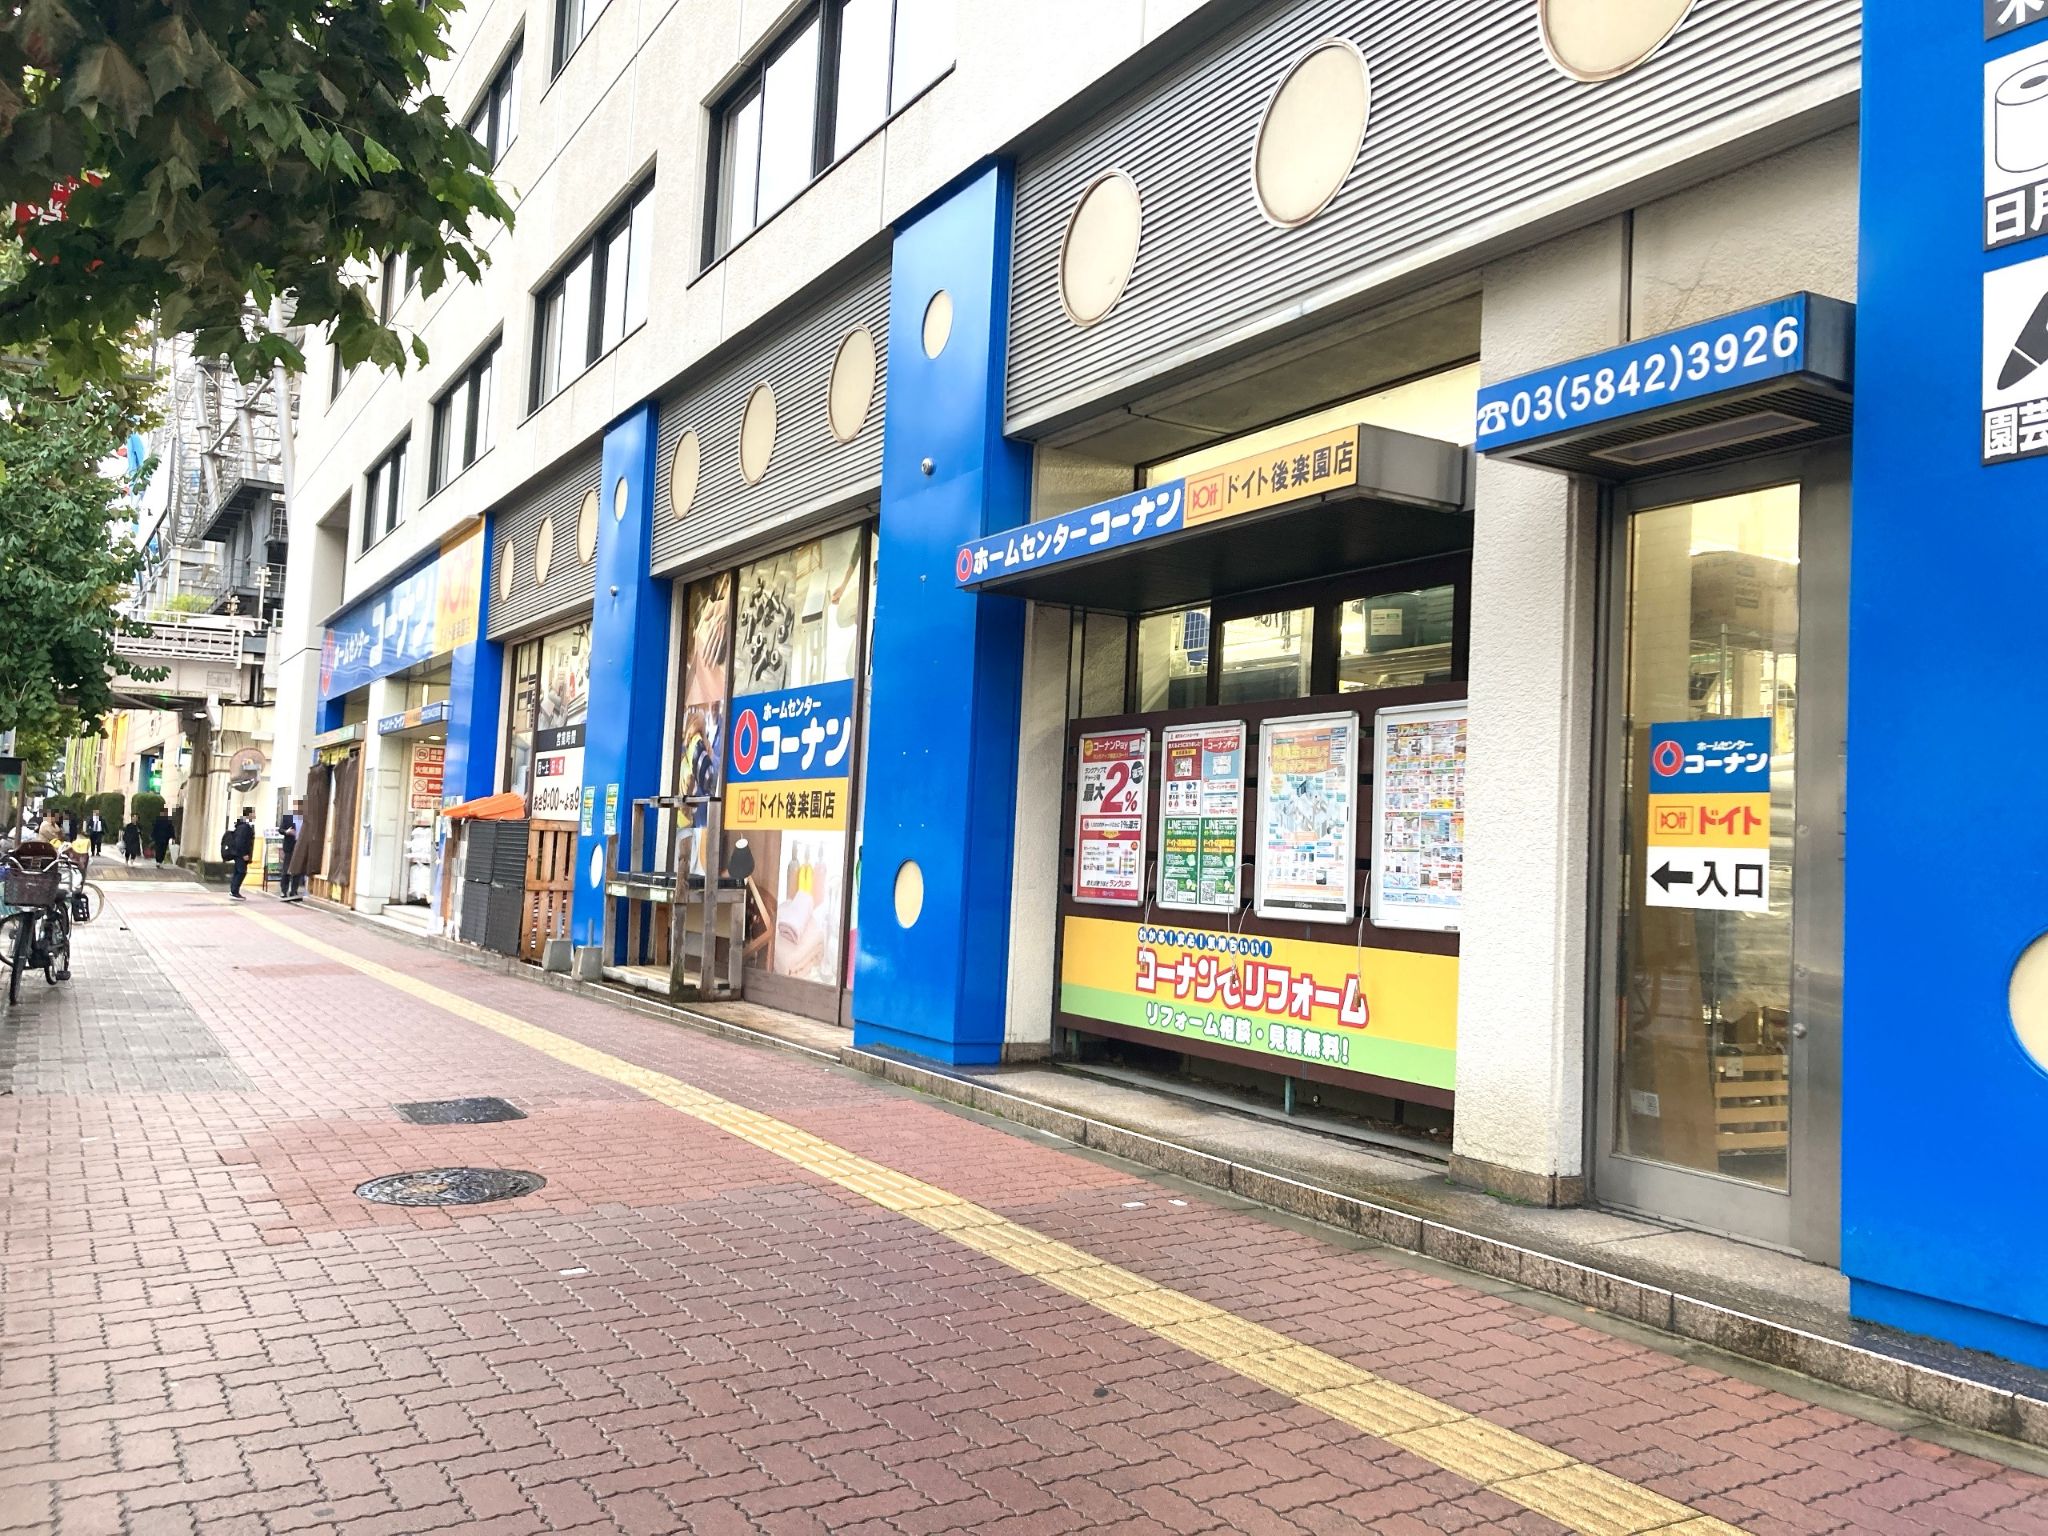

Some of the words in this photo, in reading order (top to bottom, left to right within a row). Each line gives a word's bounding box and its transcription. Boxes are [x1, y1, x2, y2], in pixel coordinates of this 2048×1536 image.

[1511, 316, 1800, 428] 03(5842)3926
[1226, 440, 1355, 504] ドイト後楽園店
[369, 570, 434, 668] コーナン
[762, 696, 822, 722] ホームセンター
[759, 716, 851, 771] コーナン
[1093, 740, 1128, 751] コーナンPay
[1696, 739, 1755, 752] ホームセンター
[1684, 752, 1769, 774] コーナン
[759, 790, 836, 819] ドイト後楽園店
[1700, 806, 1762, 835] ドイト
[1696, 861, 1764, 899] 入口
[1136, 947, 1370, 1029] コーナンでリフォーム
[1146, 1000, 1350, 1065] リフォーム相談・見積無料!
